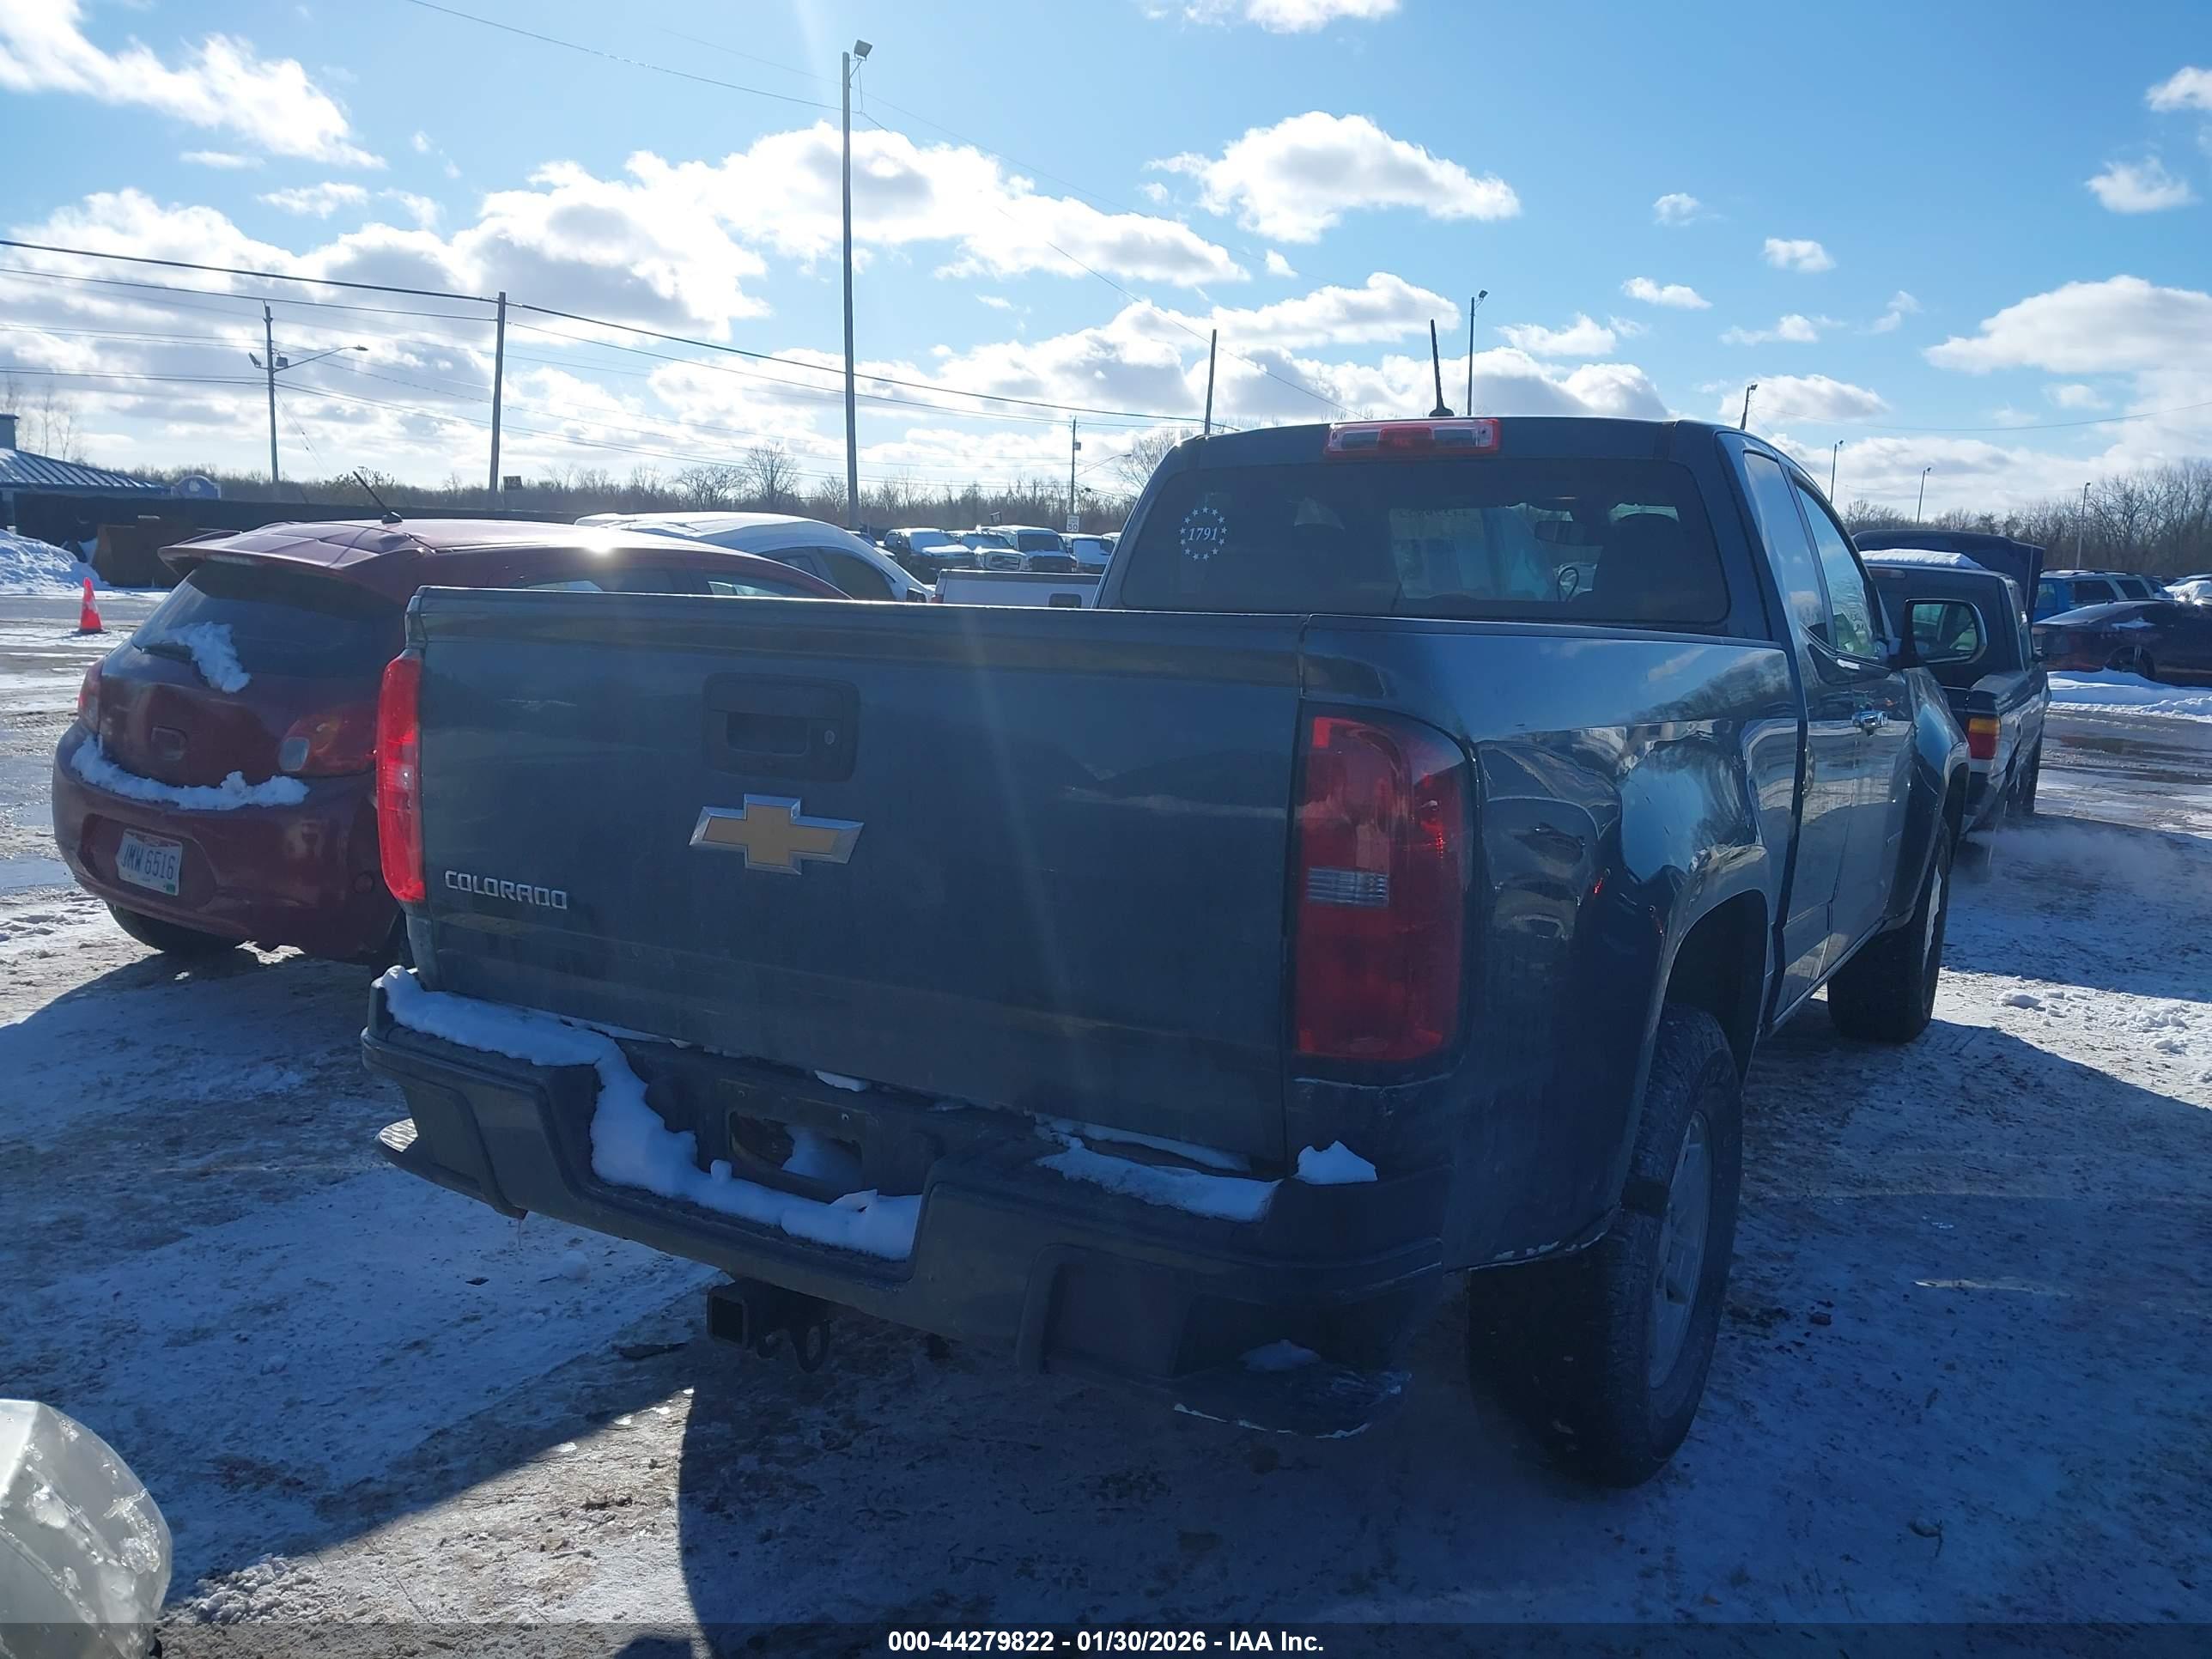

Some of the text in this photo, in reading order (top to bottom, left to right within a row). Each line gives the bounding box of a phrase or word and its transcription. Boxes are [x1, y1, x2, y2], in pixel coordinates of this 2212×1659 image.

[1188, 526, 1218, 541] 1791
[144, 850, 175, 880] 6516
[445, 870, 568, 909] COLORADO
